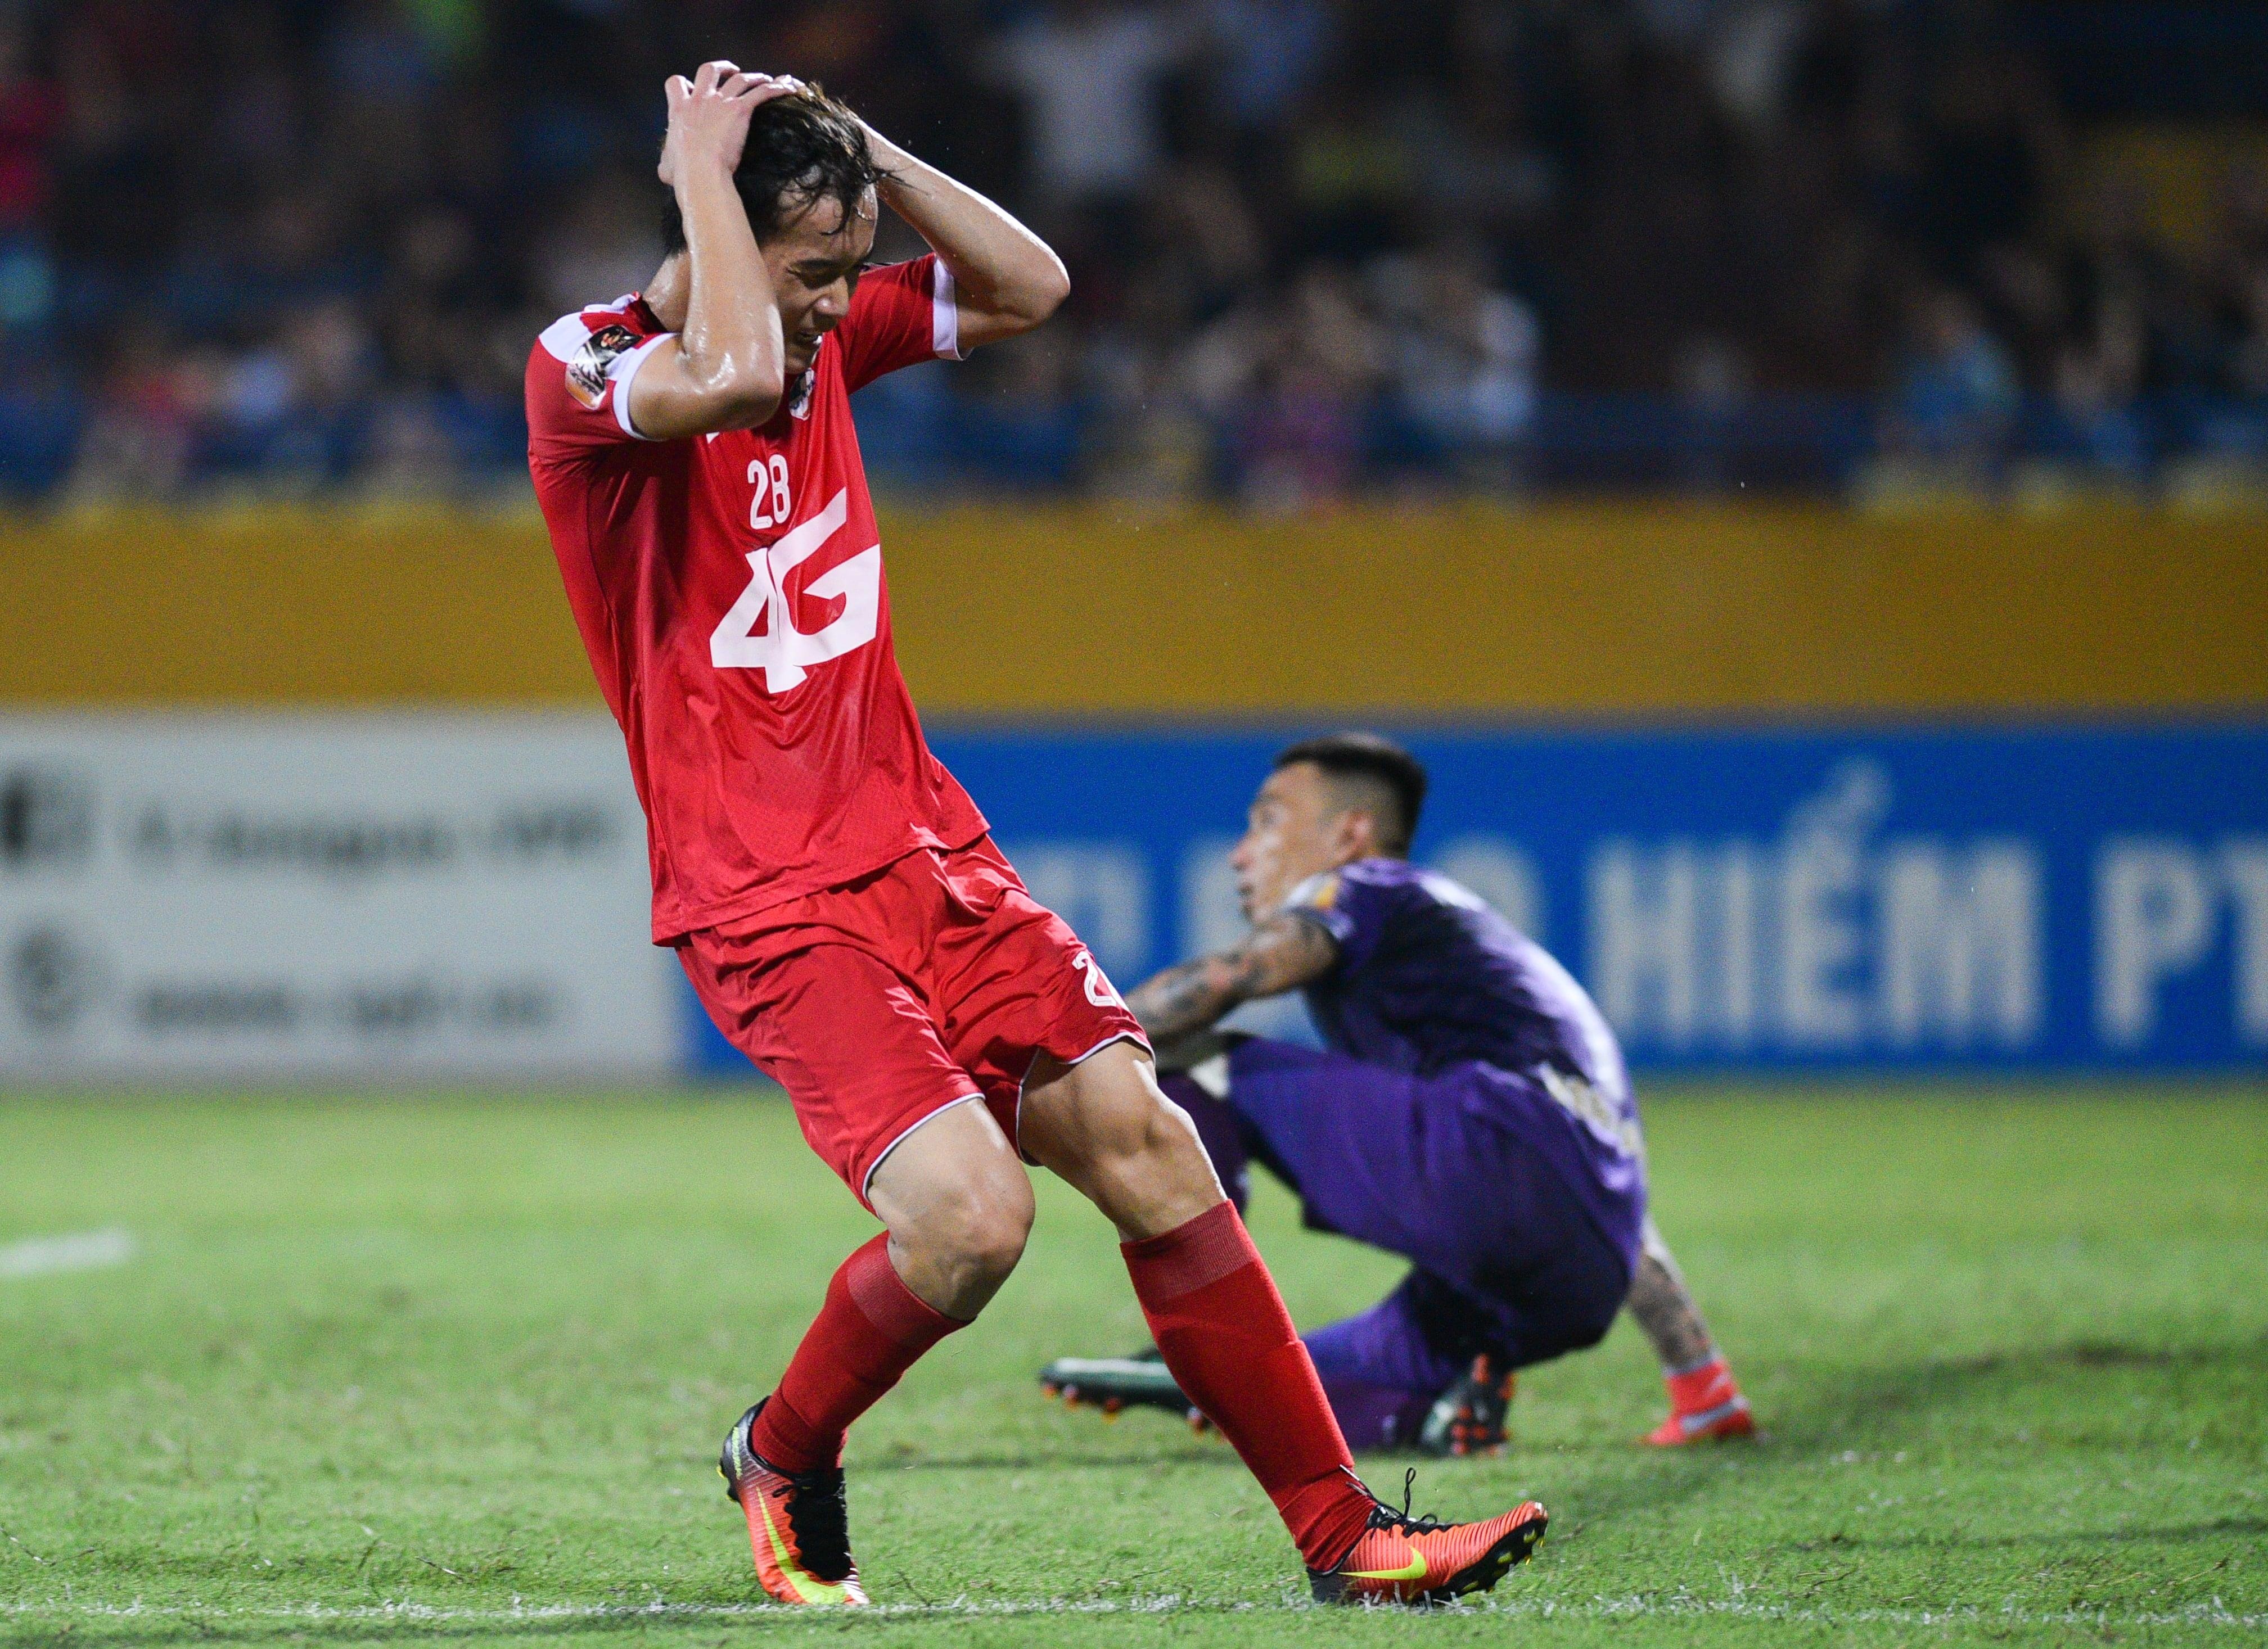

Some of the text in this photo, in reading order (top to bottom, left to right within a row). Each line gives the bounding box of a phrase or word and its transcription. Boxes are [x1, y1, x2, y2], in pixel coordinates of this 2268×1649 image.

[747, 454, 790, 530] 28
[710, 486, 881, 694] 4G
[1072, 950, 1129, 1011] 2
